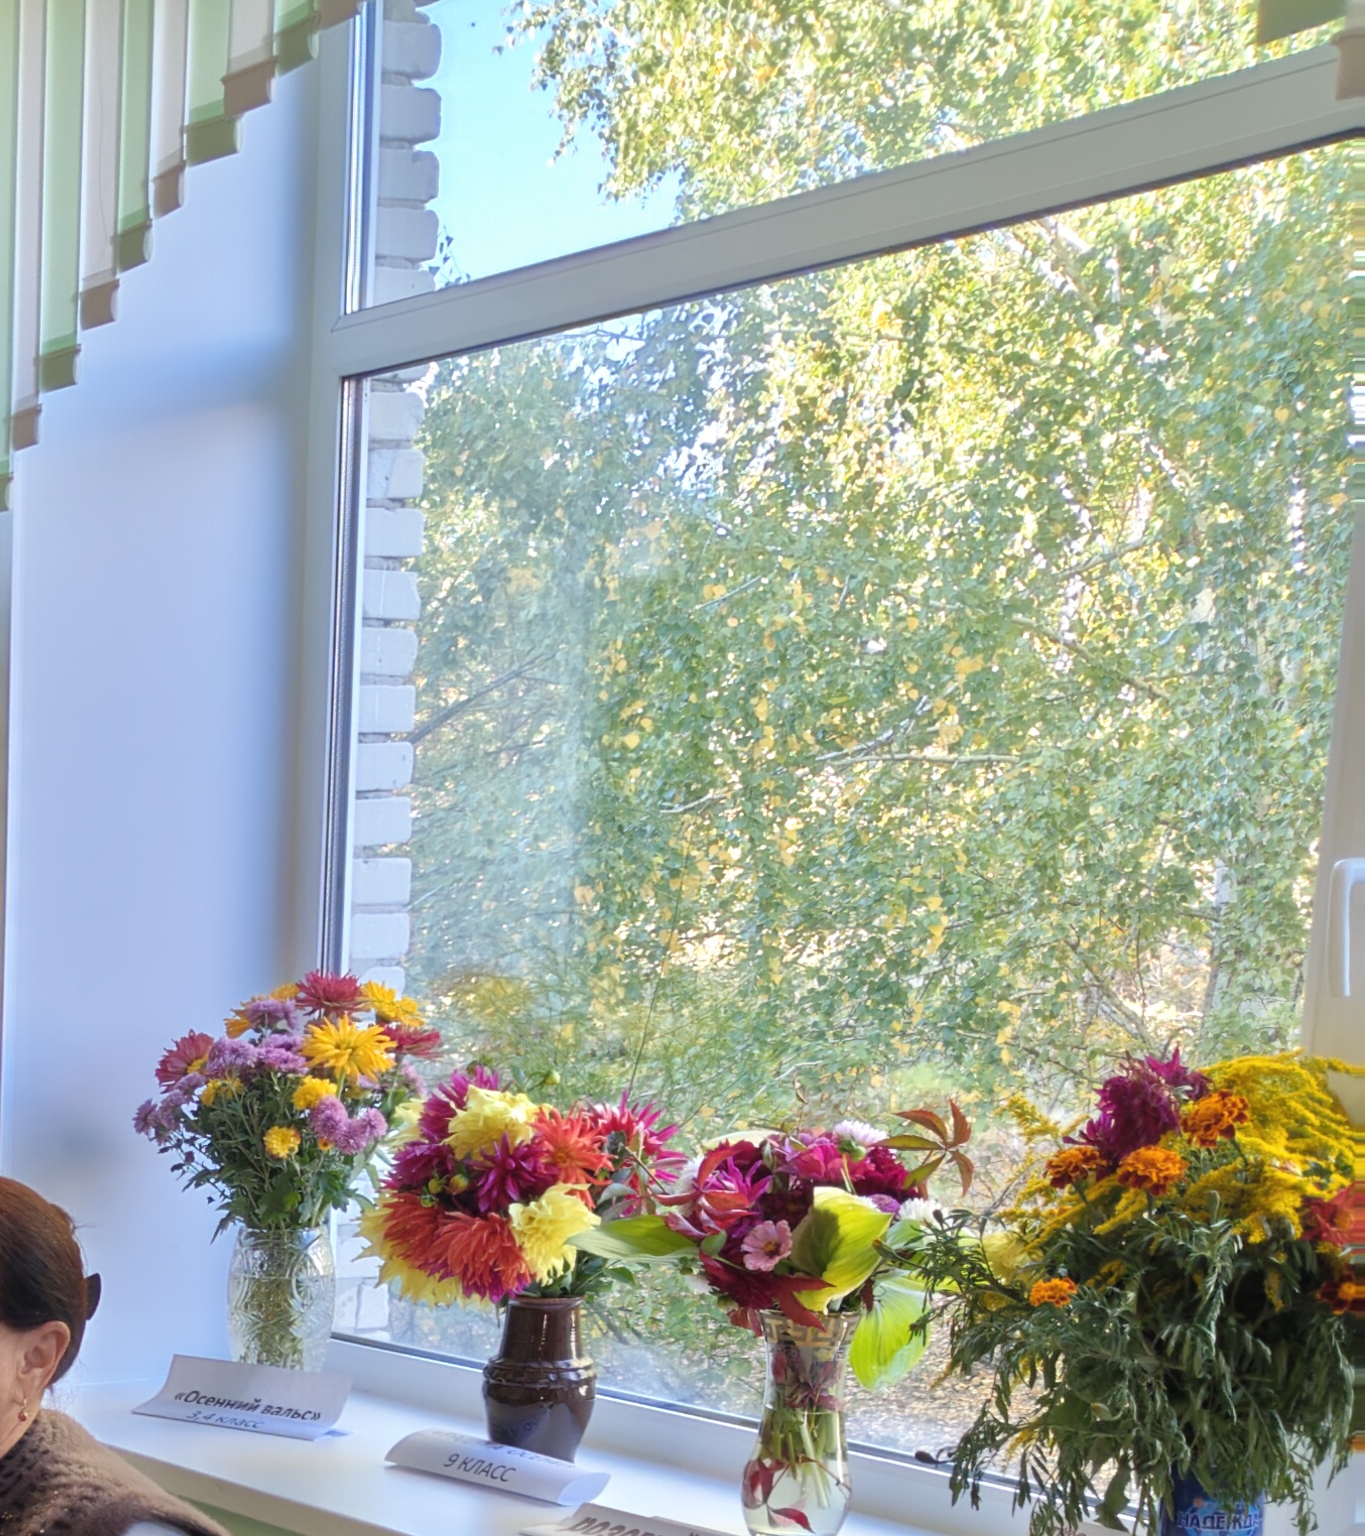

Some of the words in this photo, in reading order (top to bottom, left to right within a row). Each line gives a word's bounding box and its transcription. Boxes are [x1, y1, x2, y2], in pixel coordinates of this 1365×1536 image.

[174, 1390, 261, 1413] «Осенний
[260, 1403, 322, 1422] вальс»
[214, 1414, 265, 1430] класс
[443, 1453, 456, 1467] 9
[458, 1456, 517, 1482] КЛАСС
